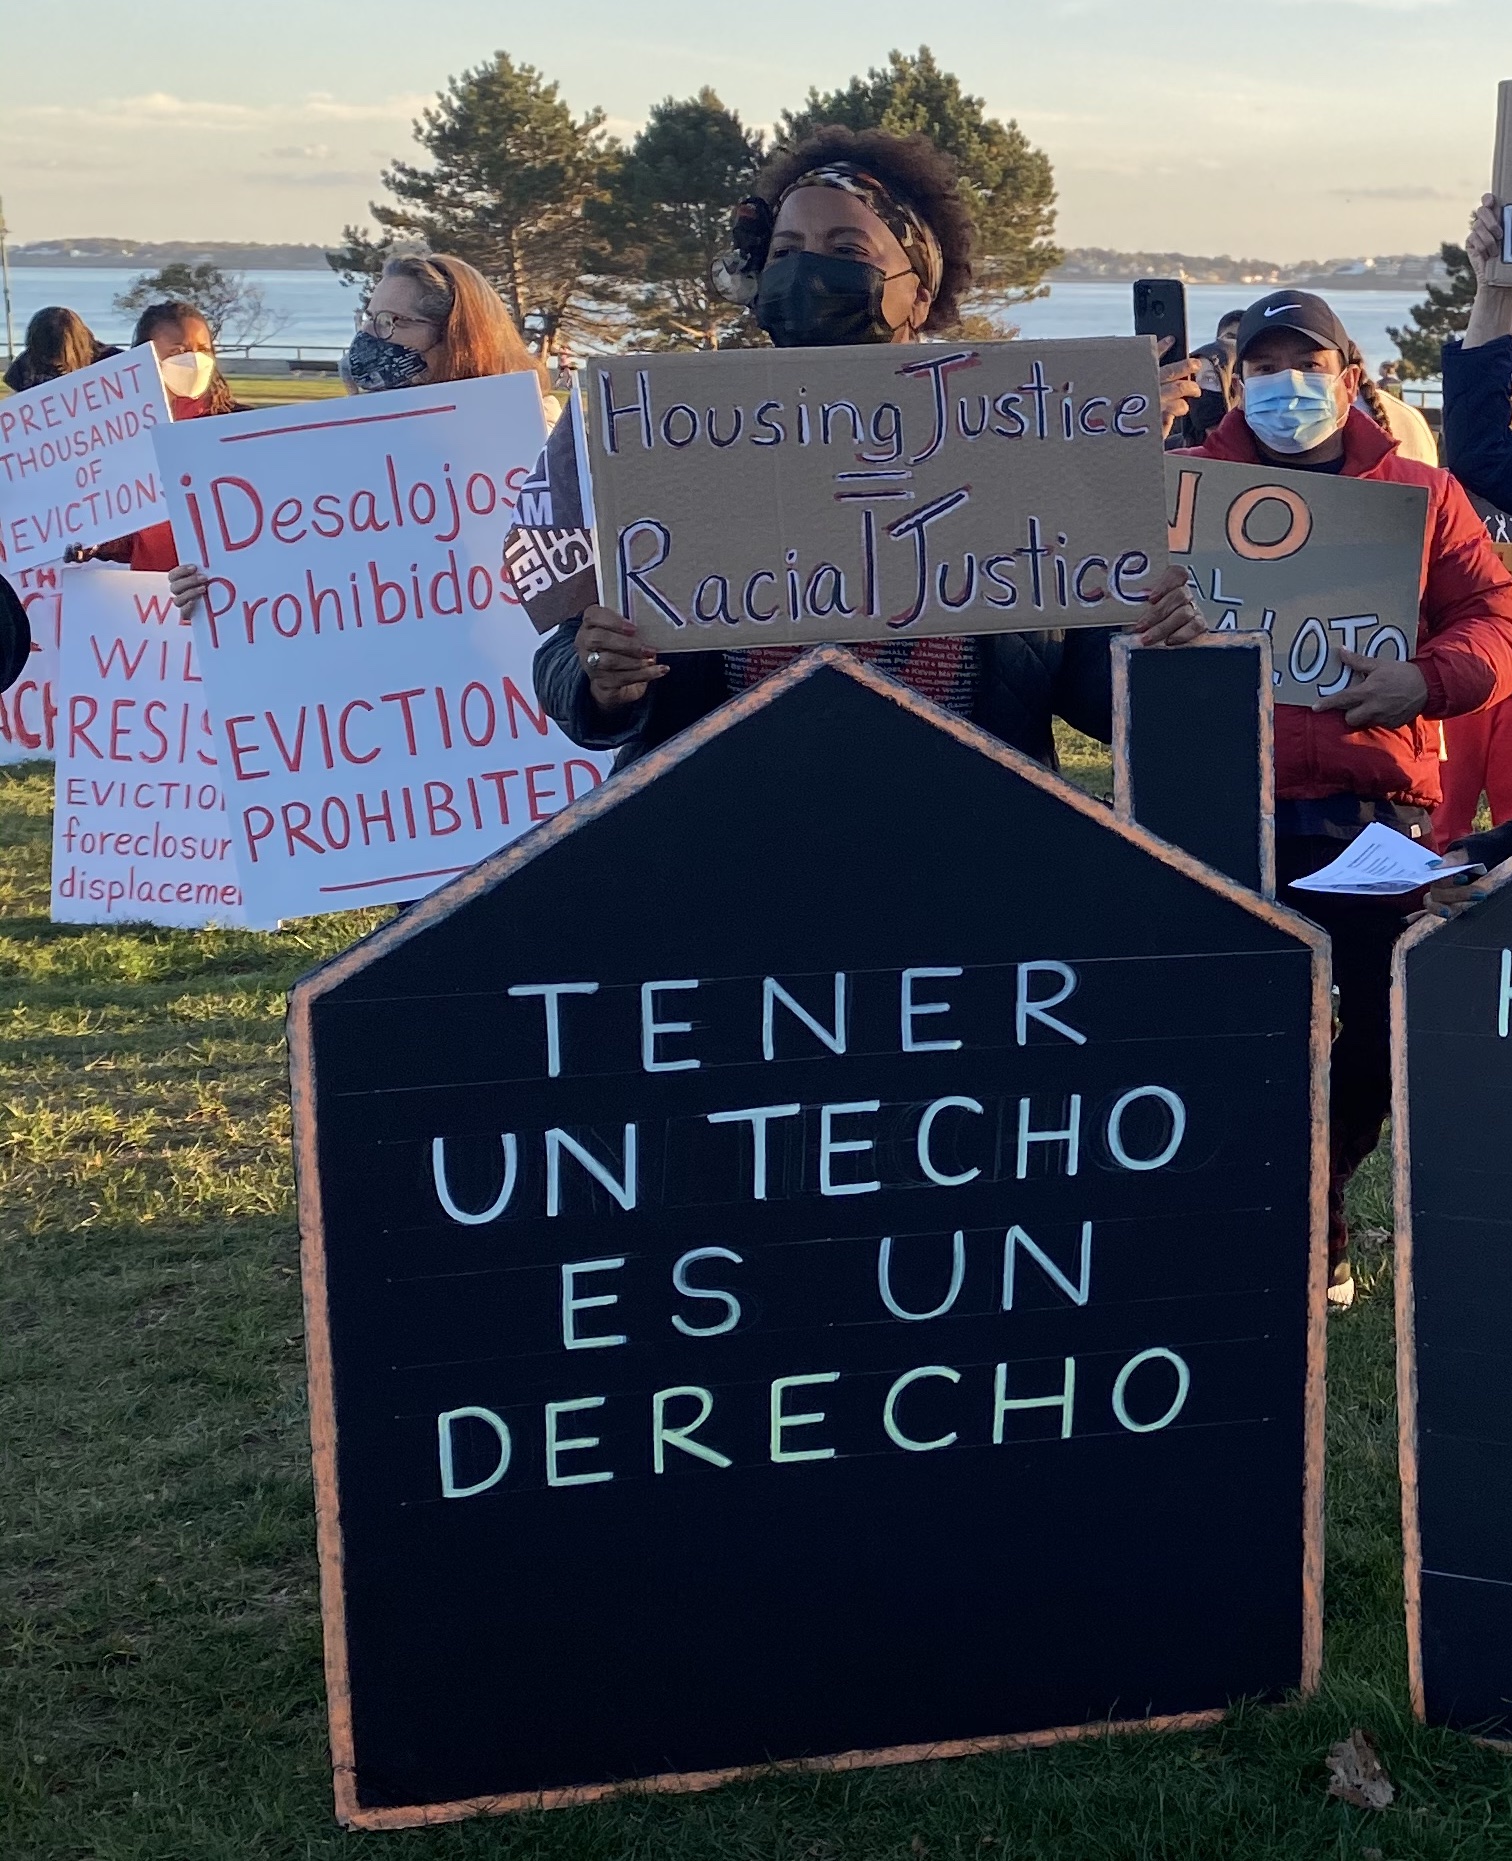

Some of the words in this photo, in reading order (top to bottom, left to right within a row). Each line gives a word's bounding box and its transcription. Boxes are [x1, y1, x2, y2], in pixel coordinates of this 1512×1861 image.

[0, 363, 141, 444] PREVENT
[0, 403, 157, 482] THOUSANDS
[601, 369, 904, 464] Housing
[895, 350, 1150, 465] Justice
[10, 473, 165, 553] EVICTION
[75, 459, 102, 488] OF
[616, 510, 878, 628] Racial
[884, 485, 1151, 629] Justice
[133, 594, 192, 626] W
[90, 635, 203, 681] WIL
[67, 778, 226, 811] EVICTIO
[243, 759, 602, 863] PROHIBITED
[62, 816, 232, 860] foreclosur
[59, 866, 242, 913] displaceme
[507, 959, 1089, 1078] TENER
[431, 1122, 636, 1225] UN
[706, 1085, 1186, 1200] TECHO
[561, 1246, 744, 1350] ES
[877, 1221, 1093, 1321] UN
[437, 1346, 1191, 1499] DERECHO
